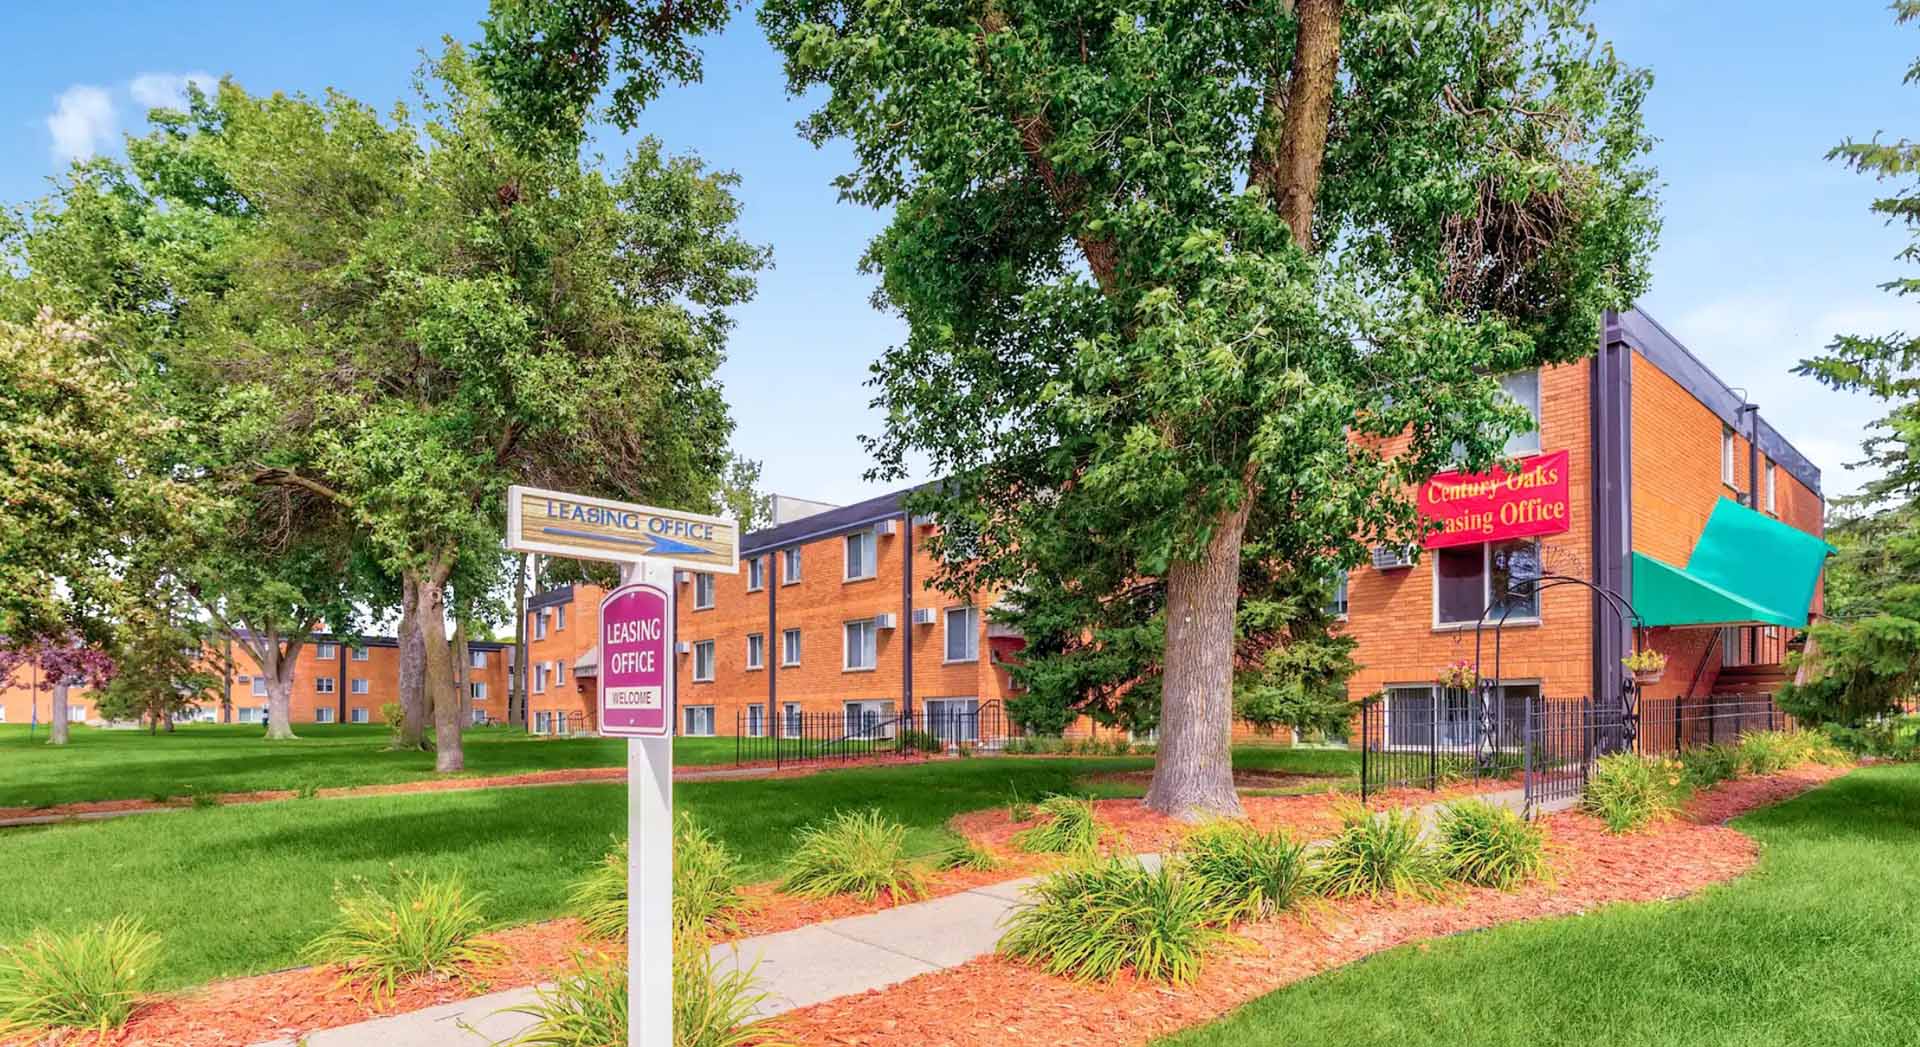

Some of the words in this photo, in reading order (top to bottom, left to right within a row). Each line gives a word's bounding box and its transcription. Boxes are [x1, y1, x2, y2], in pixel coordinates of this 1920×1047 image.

[1428, 479, 1499, 504] Century
[1506, 465, 1558, 491] Oaks
[547, 501, 639, 529] LEASING
[647, 517, 713, 541] OFFICE
[1500, 498, 1564, 525] Office
[607, 618, 661, 645] LEASING
[611, 651, 655, 674] OFFICE
[613, 690, 652, 705] WELCOME
